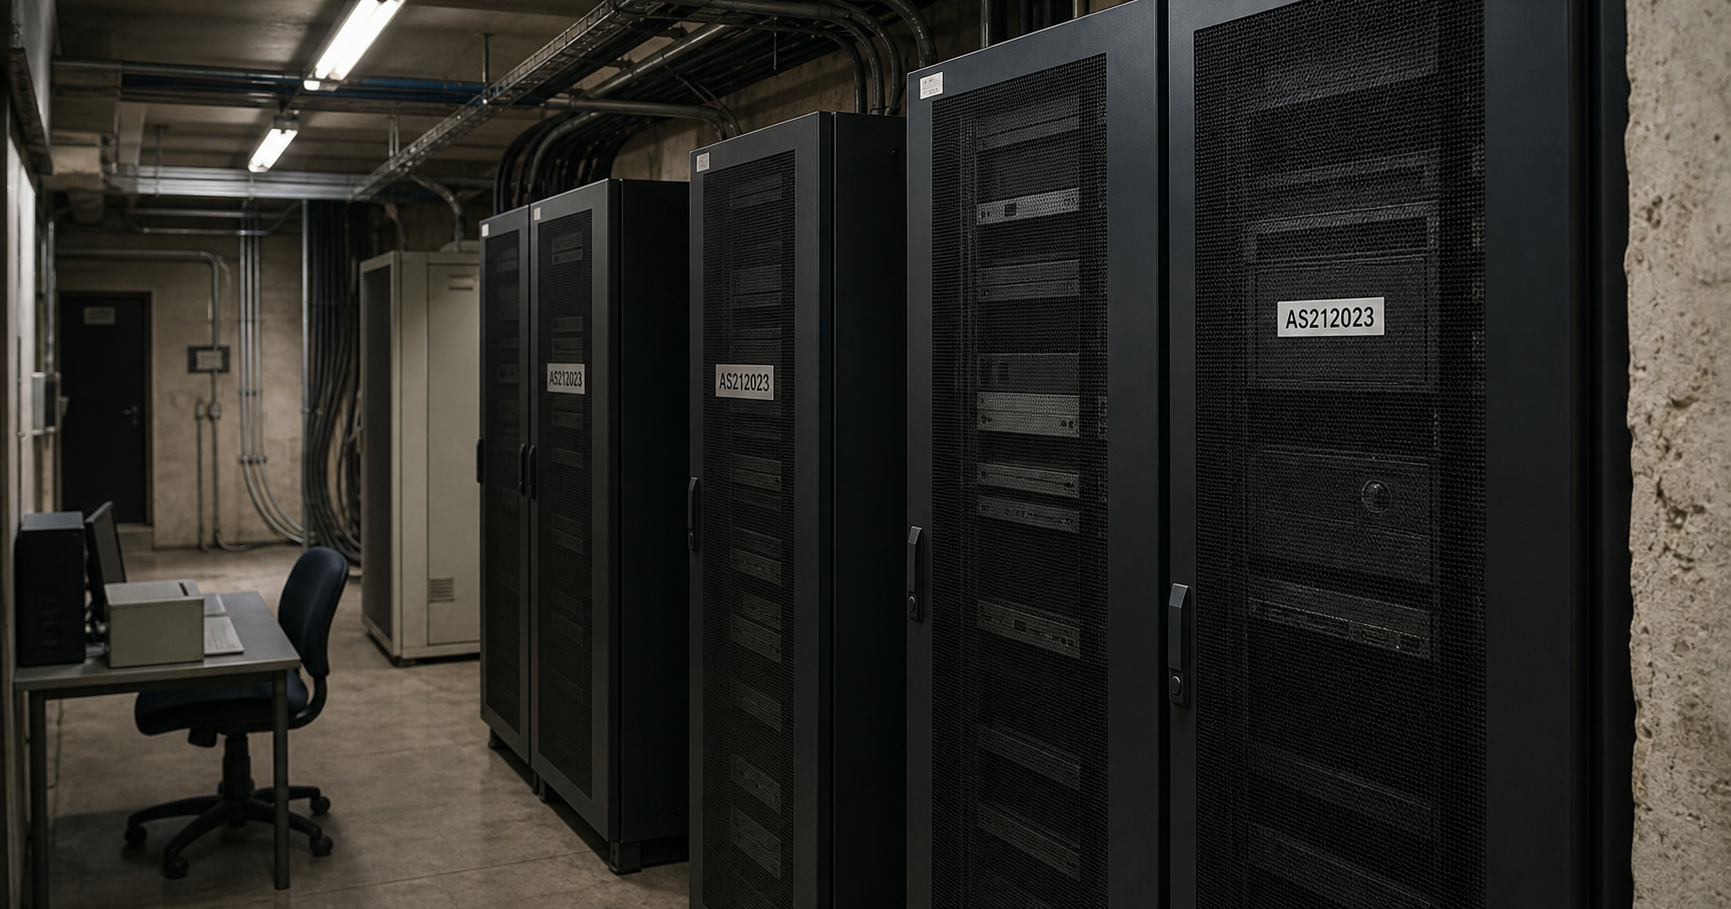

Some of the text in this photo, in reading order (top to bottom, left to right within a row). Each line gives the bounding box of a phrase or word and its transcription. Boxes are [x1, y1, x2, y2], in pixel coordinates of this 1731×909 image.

[1285, 306, 1374, 329] AS212023
[549, 370, 583, 388] AS212023
[718, 372, 770, 392] AS212023
